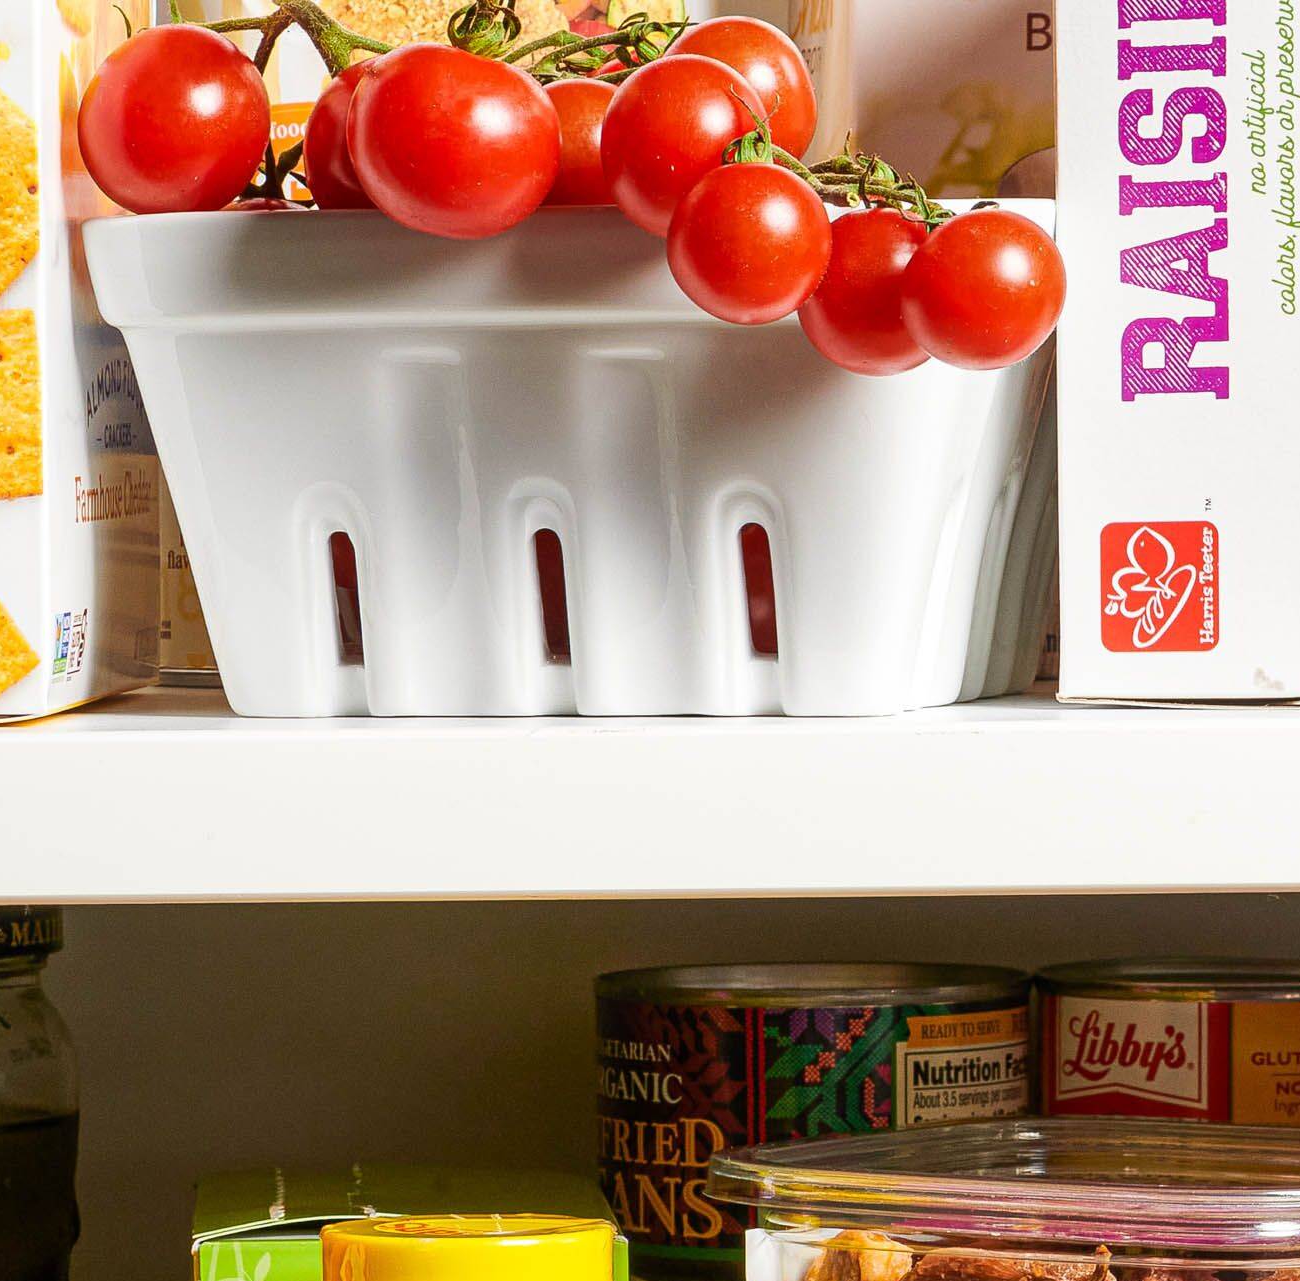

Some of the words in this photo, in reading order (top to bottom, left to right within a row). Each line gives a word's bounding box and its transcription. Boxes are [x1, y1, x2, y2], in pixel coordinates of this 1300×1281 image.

[1242, 50, 1274, 157] artificial
[1276, 99, 1294, 131] or
[1251, 162, 1266, 194] no
[75, 474, 123, 523] Farmhouse
[1200, 526, 1215, 584] Teeter
[1200, 586, 1215, 644] Harris
[912, 1055, 1001, 1086] Nutrition
[1063, 1010, 1187, 1082] Libby's
